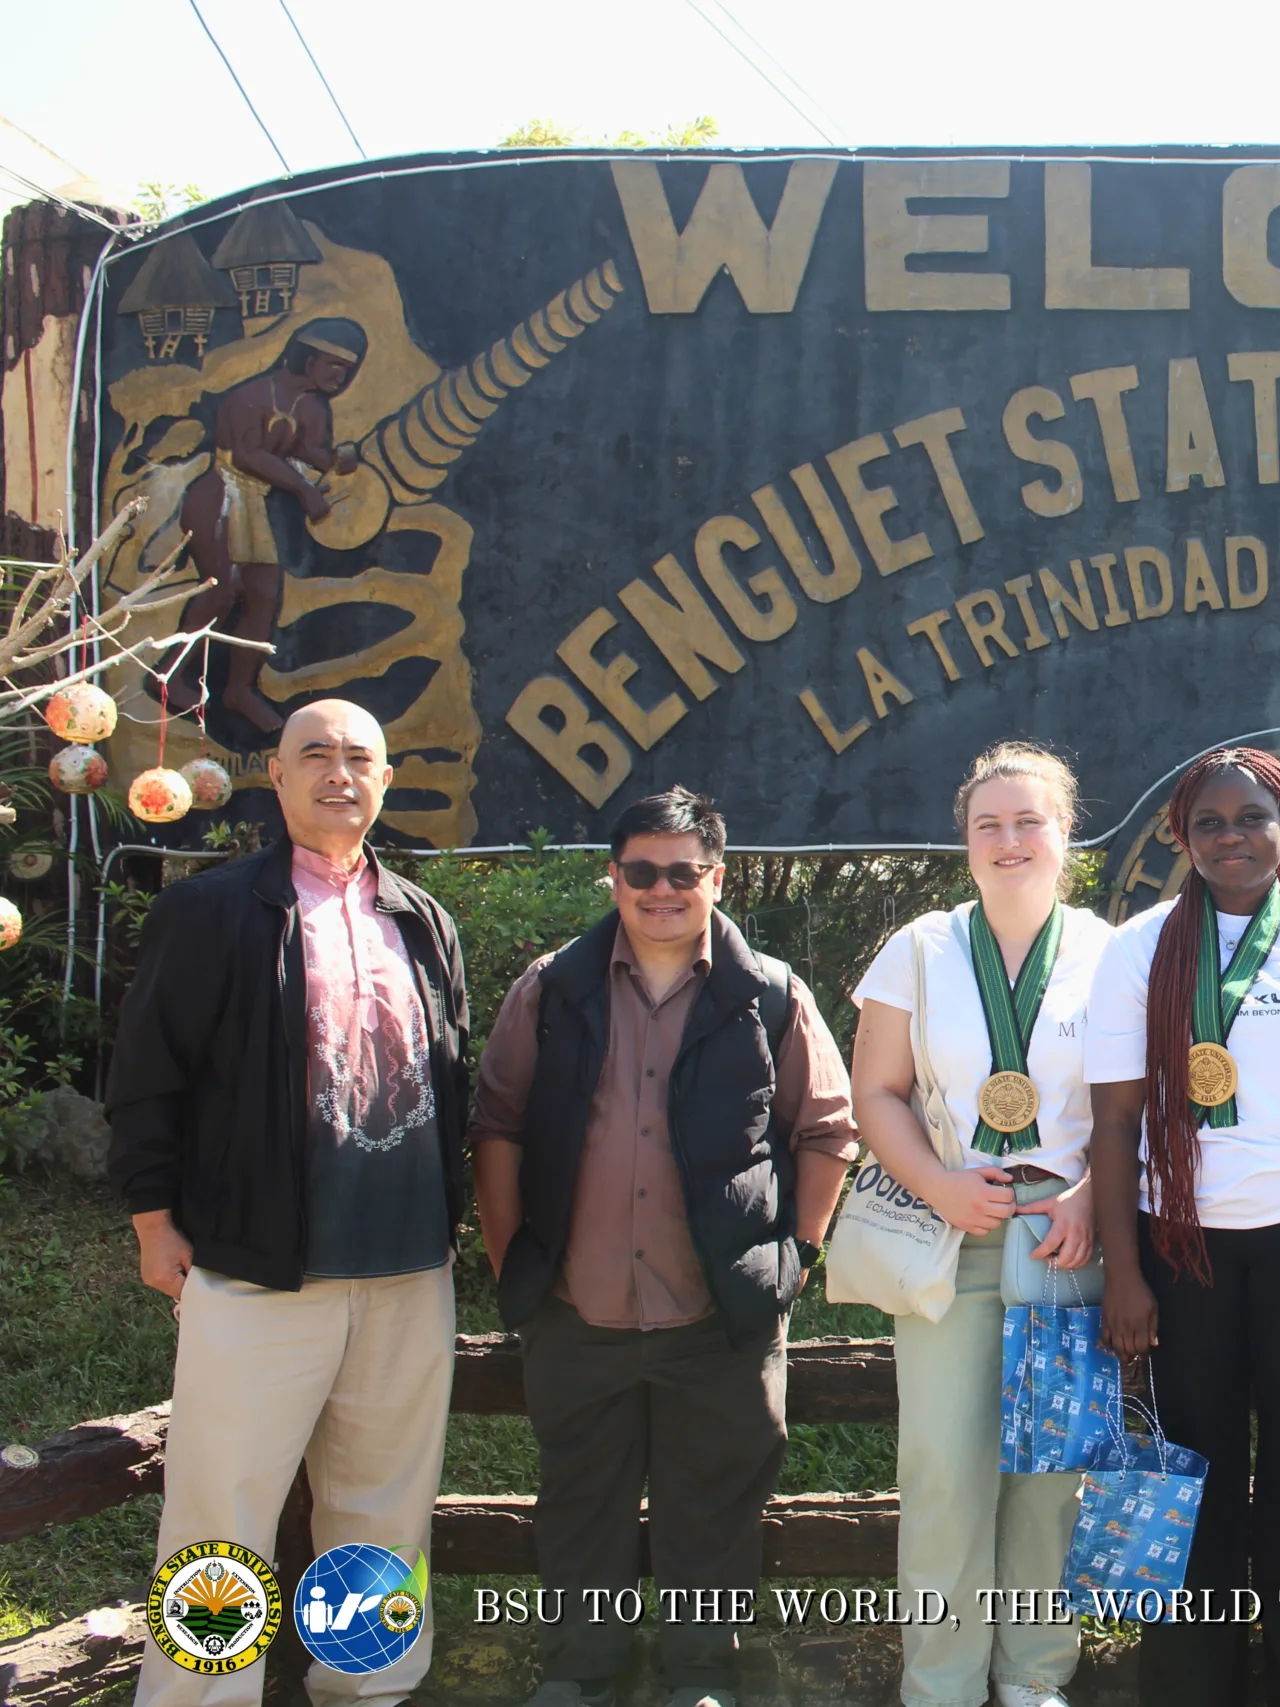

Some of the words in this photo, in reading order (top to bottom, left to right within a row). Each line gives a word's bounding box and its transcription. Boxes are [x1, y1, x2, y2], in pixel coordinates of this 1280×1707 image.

[504, 407, 986, 810] BENGUET
[799, 647, 915, 755] LA
[907, 535, 1270, 682] TRINIDAD
